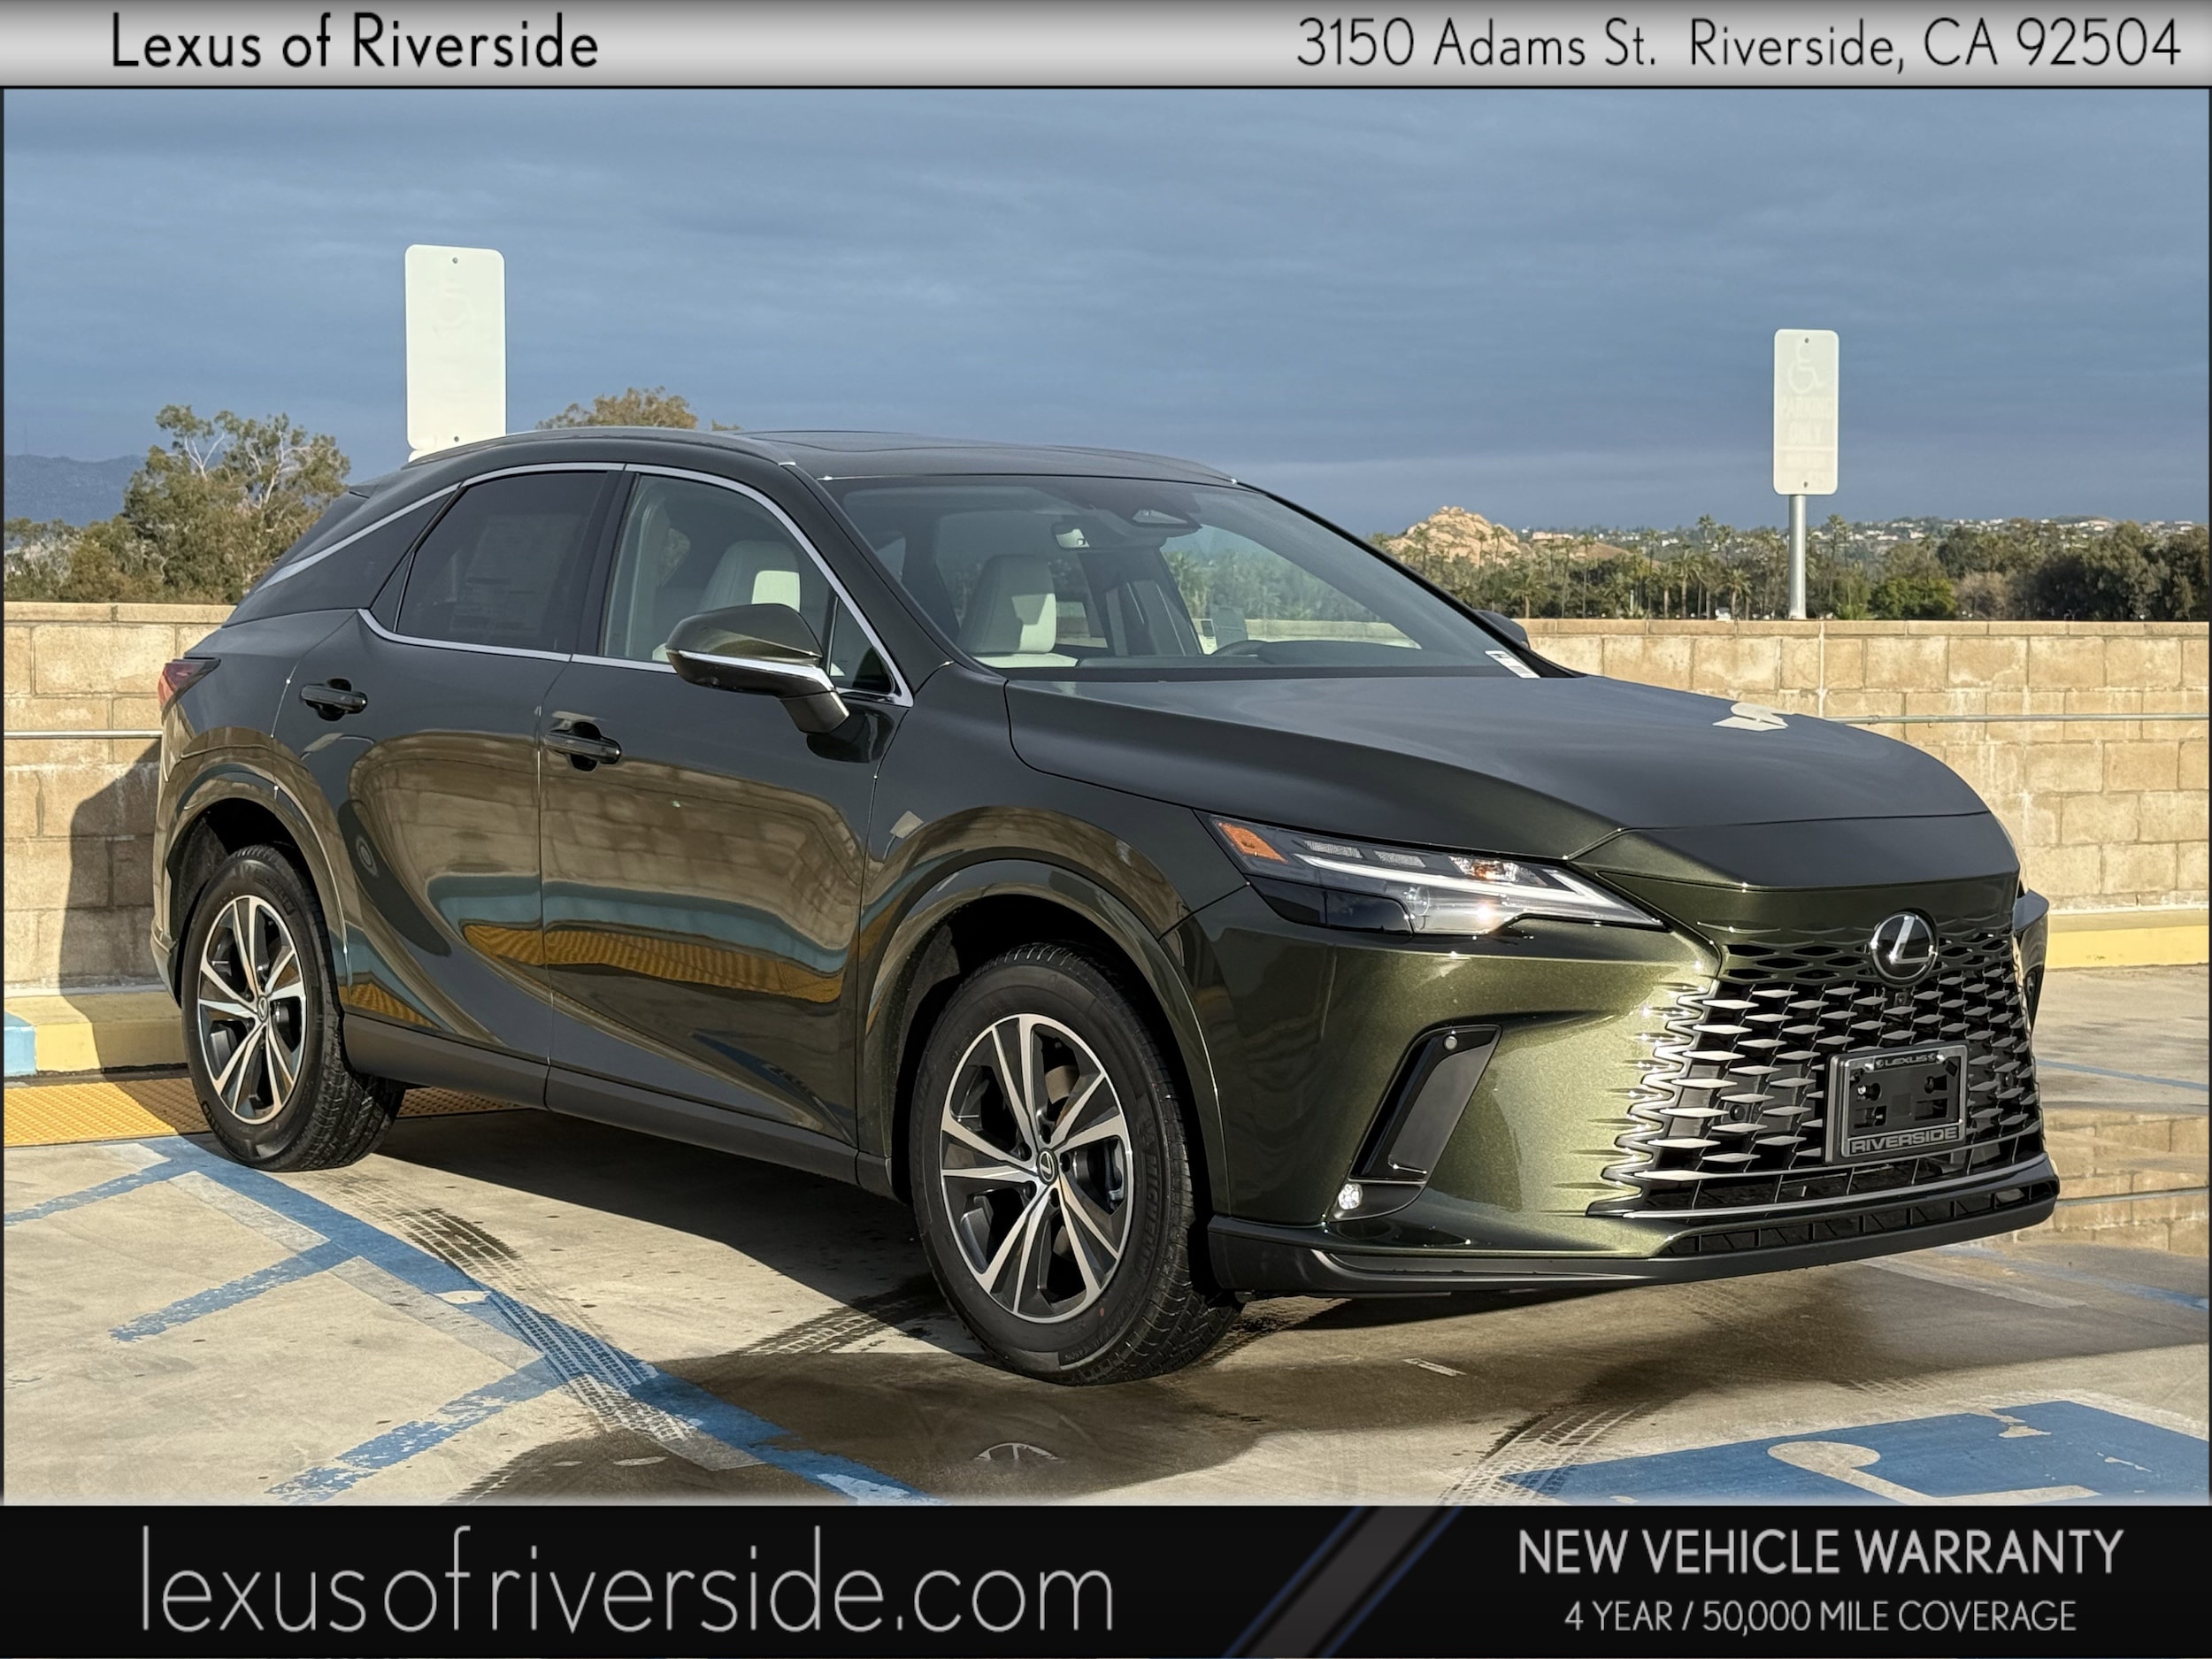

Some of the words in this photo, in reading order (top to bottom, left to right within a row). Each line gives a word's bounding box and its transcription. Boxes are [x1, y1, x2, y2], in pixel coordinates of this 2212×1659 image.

[1885, 1054, 1928, 1066] LEXUS
[1852, 1128, 1957, 1153] RIVERSIDE
[1137, 1153, 1159, 1275] MICHELIN
